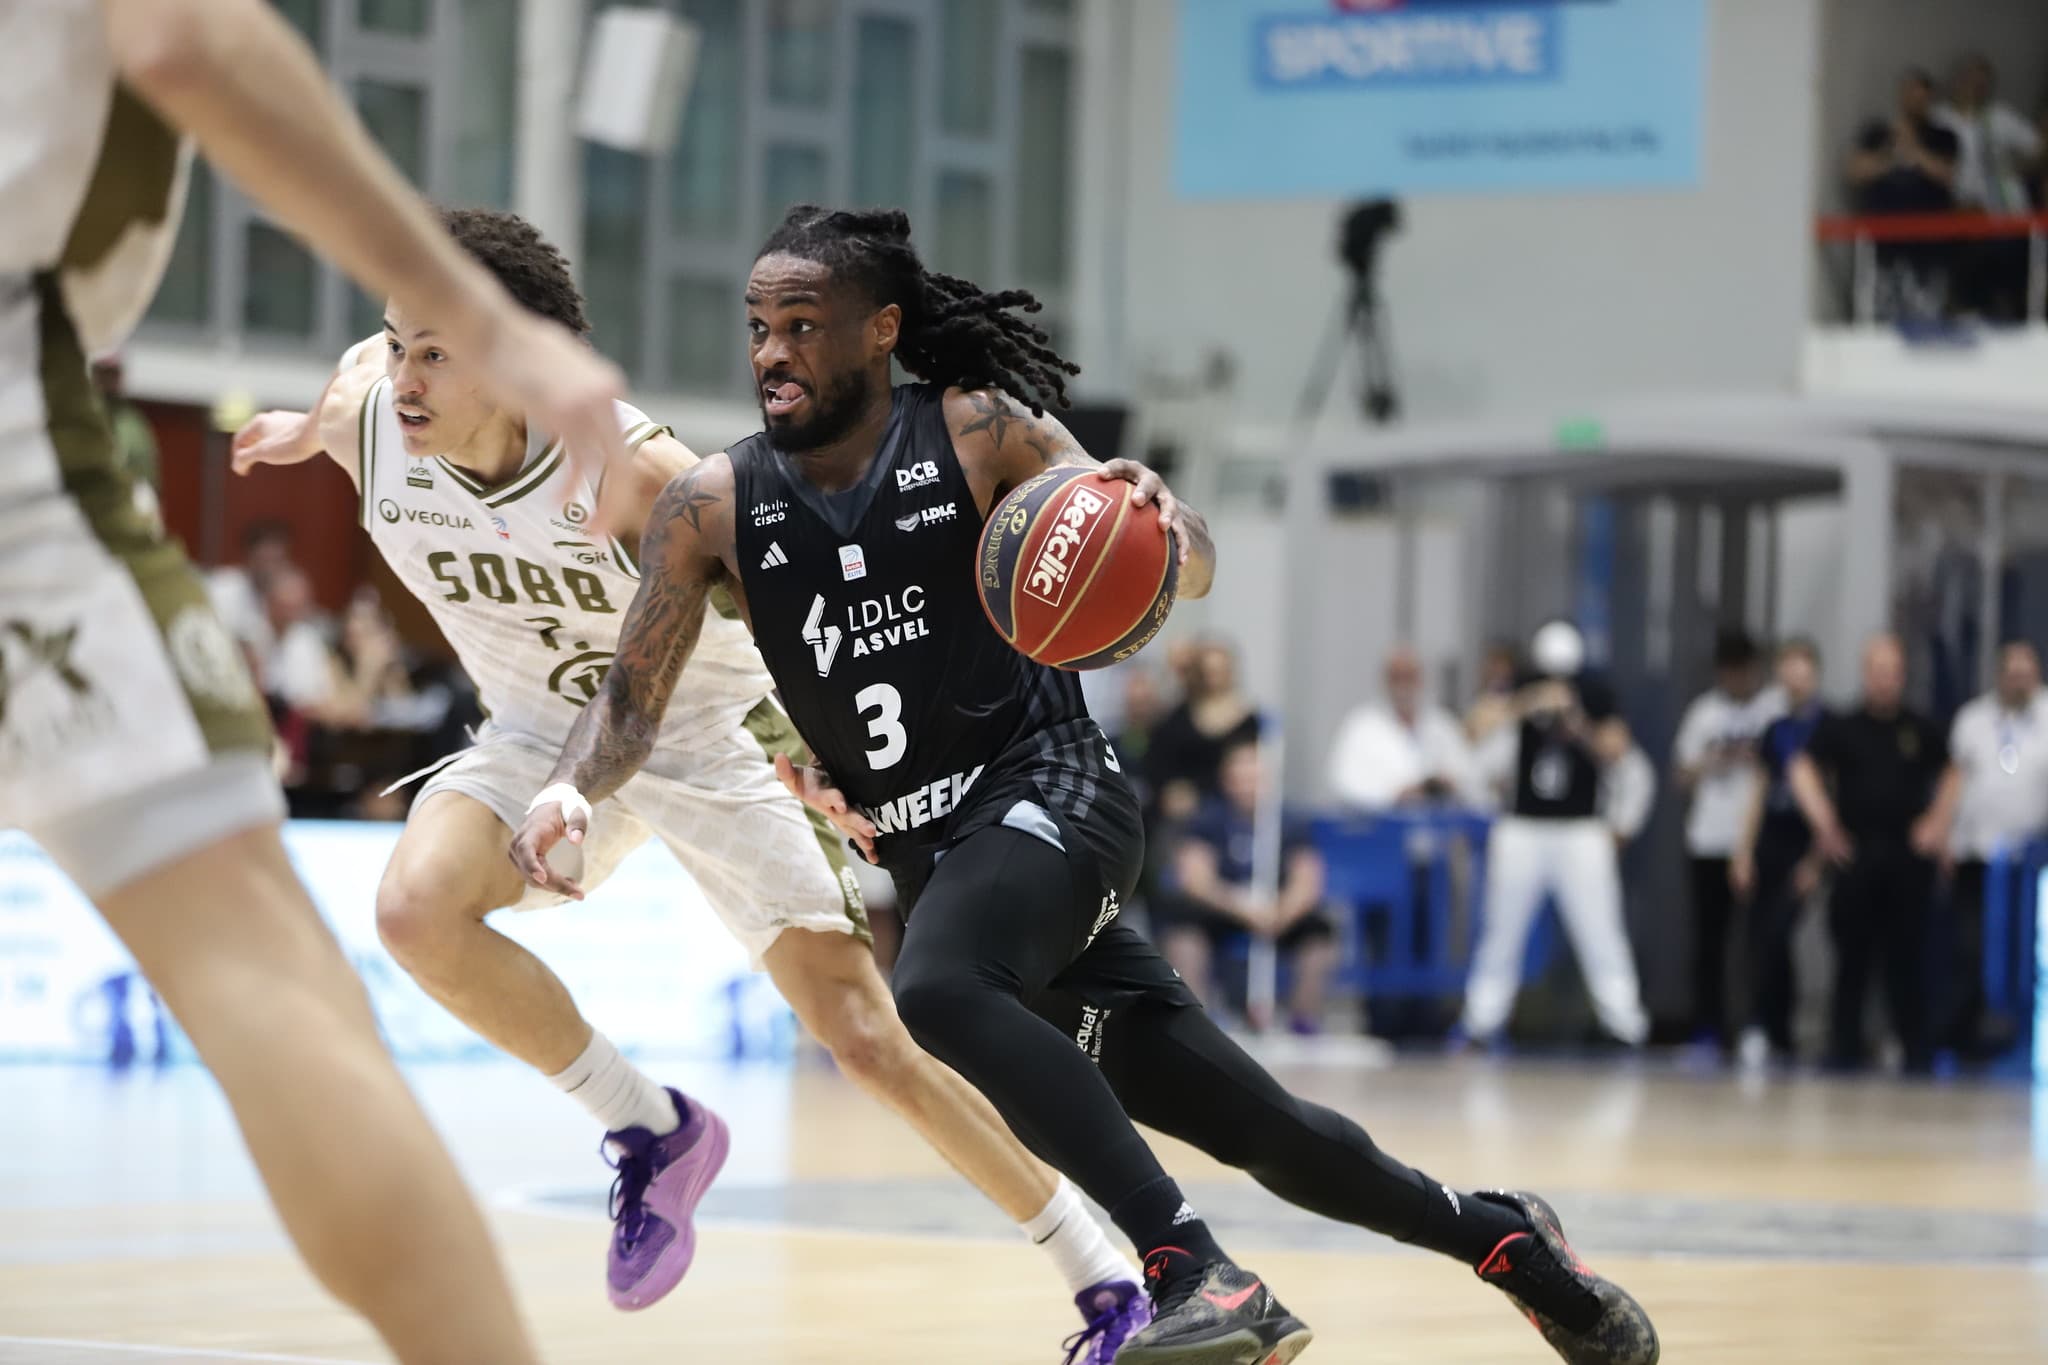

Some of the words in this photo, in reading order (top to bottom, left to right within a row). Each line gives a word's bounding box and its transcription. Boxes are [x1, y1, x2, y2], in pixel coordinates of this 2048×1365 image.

[895, 460, 939, 487] DCB
[404, 508, 474, 530] VEOLIA
[921, 502, 957, 521] LDLC
[1031, 488, 1104, 596] Betclic
[847, 585, 926, 632] LDLC
[852, 617, 930, 658] ASVEL
[855, 683, 907, 770] 3
